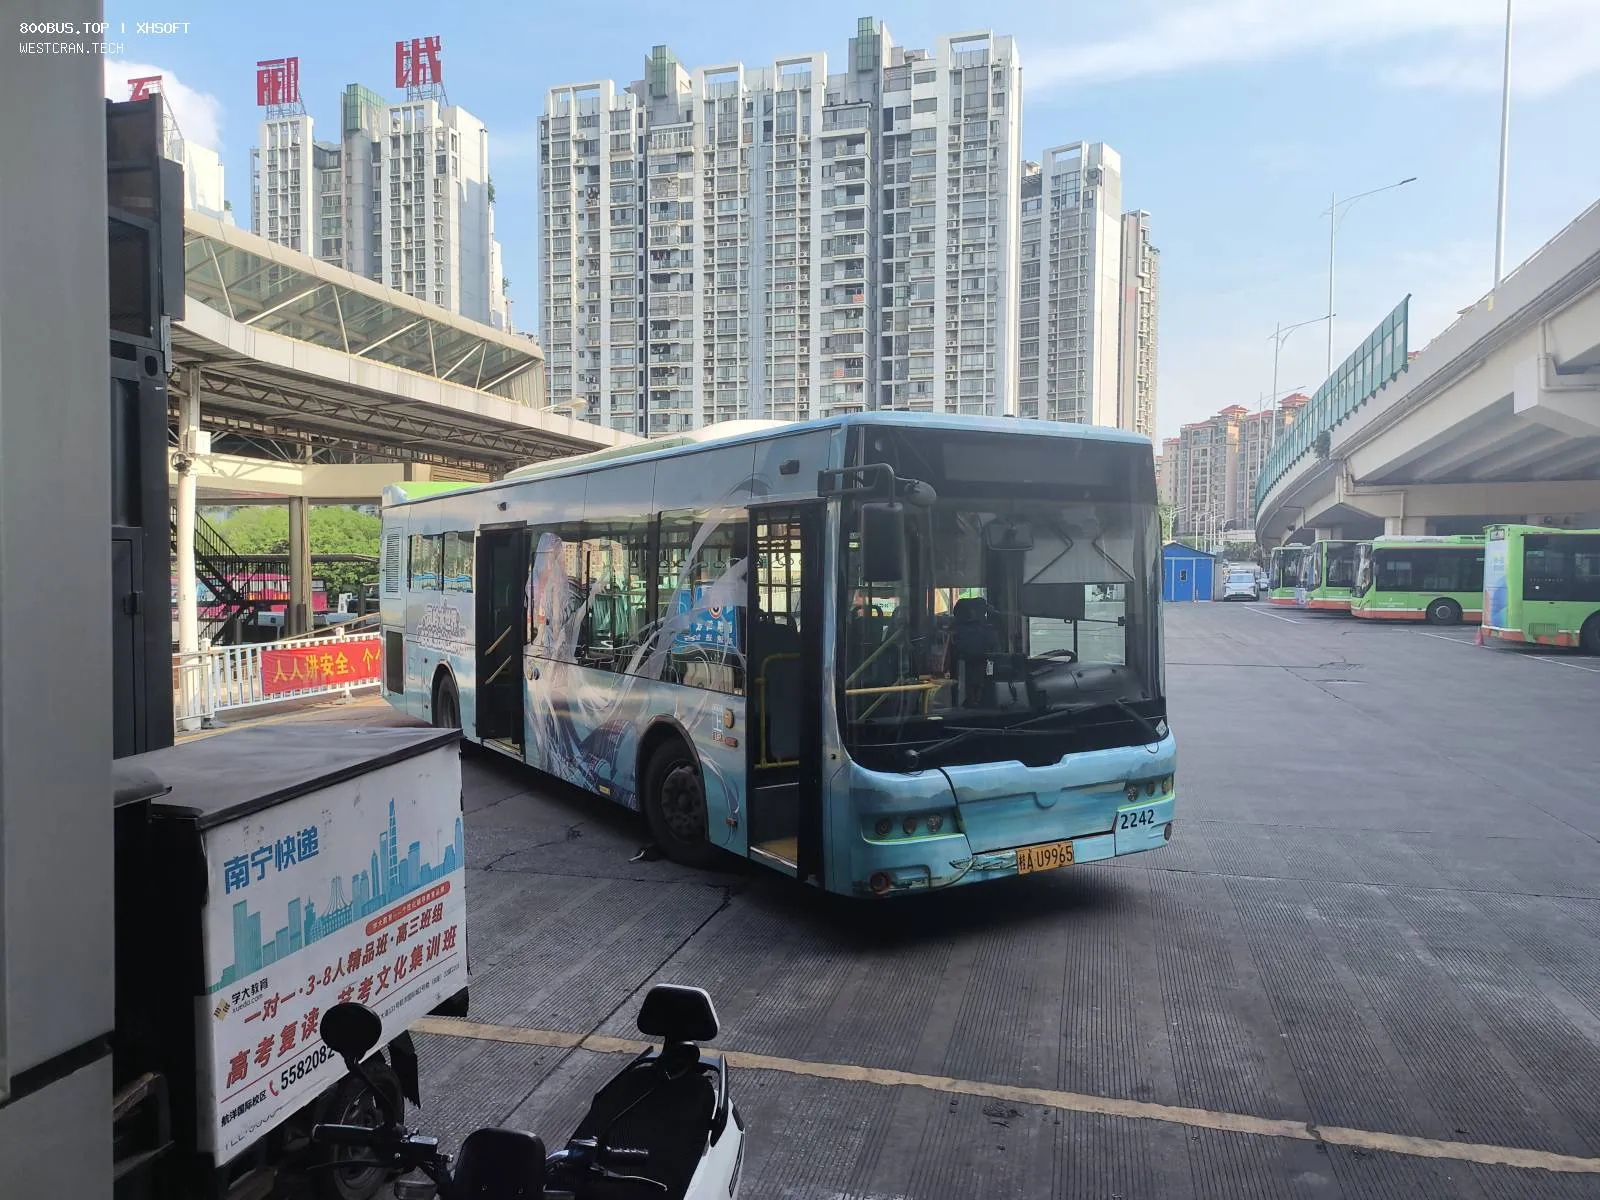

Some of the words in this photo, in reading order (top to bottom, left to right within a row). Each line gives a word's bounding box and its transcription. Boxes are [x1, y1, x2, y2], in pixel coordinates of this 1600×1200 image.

[1120, 809, 1155, 830] 2242
[223, 825, 319, 894] 南宁快递
[231, 977, 269, 1006] 学大教育
[221, 1089, 267, 1128] 航洋国际校区
